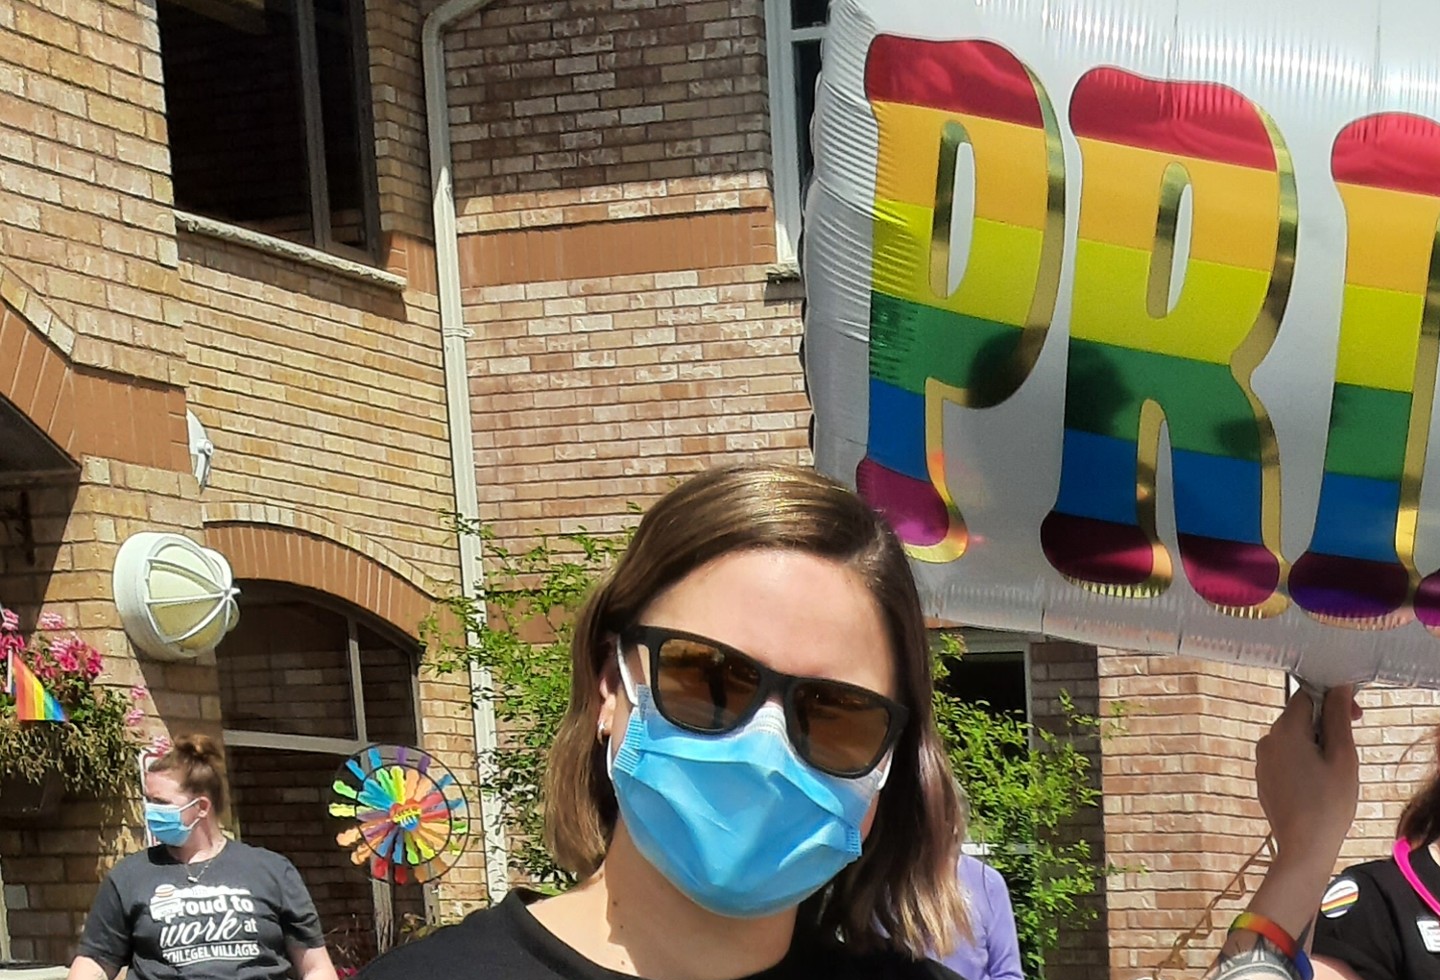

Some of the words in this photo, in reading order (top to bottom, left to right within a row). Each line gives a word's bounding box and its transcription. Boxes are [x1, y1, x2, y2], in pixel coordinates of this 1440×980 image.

[230, 895, 254, 912] to
[160, 909, 242, 948] work
[243, 918, 258, 933] at
[211, 943, 260, 957] VILLAGES
